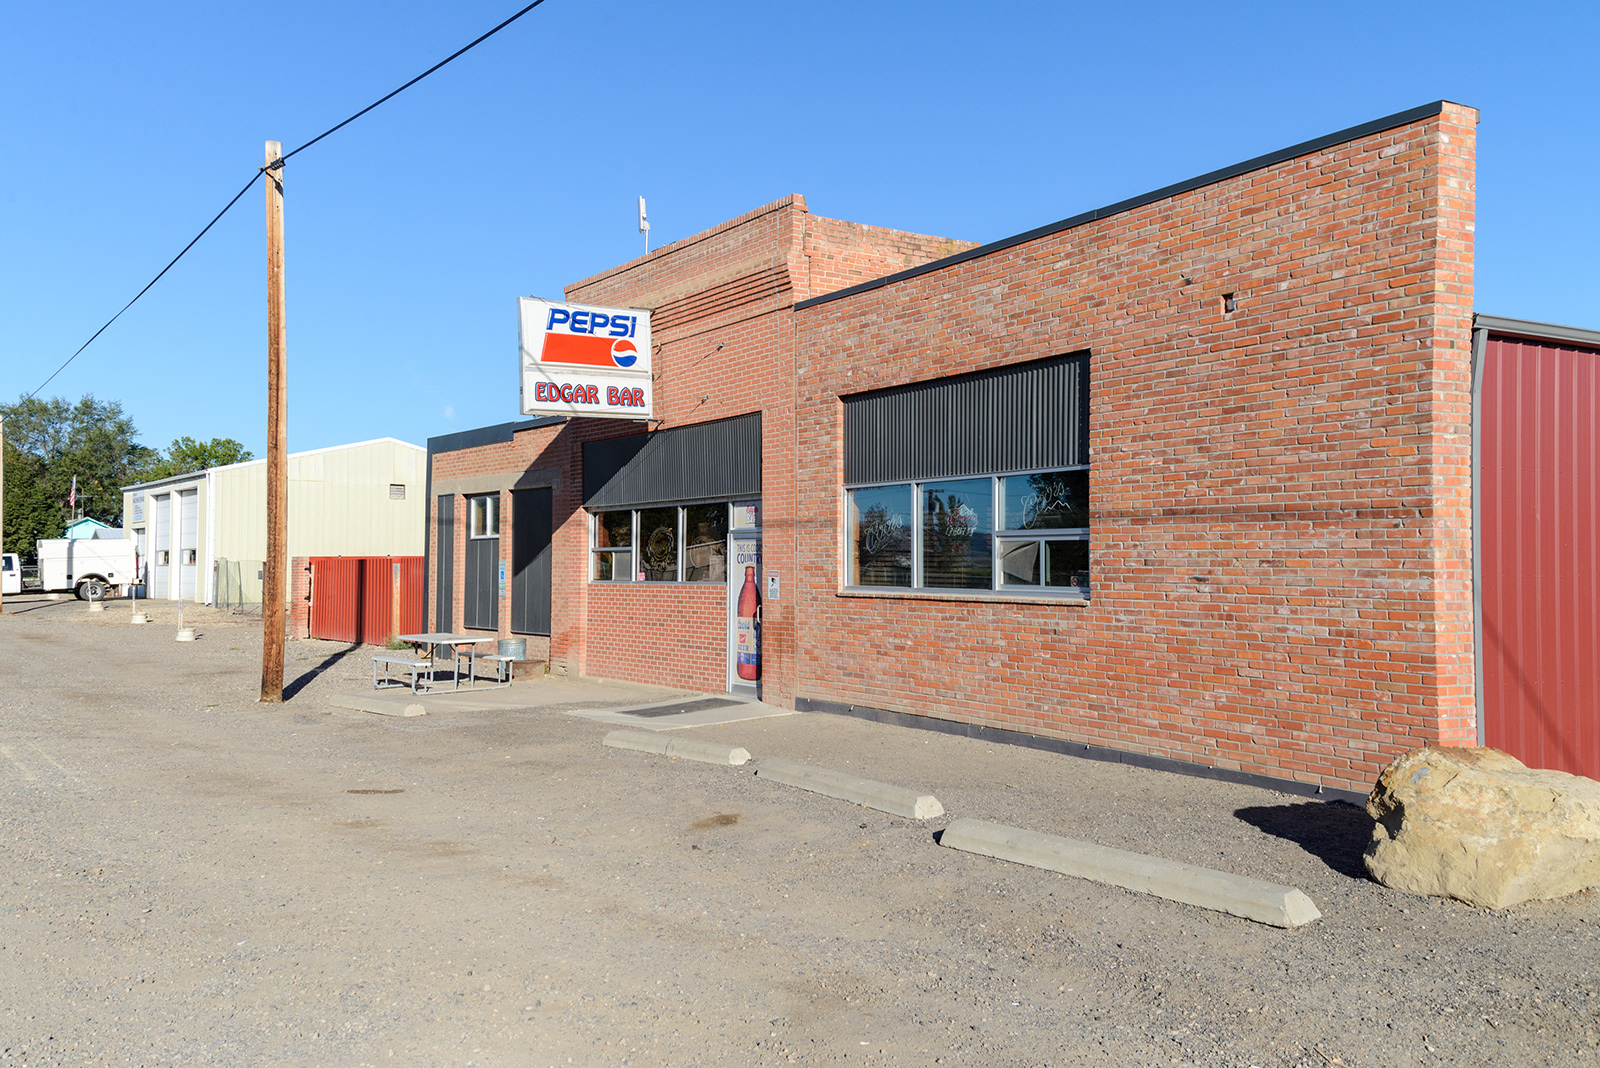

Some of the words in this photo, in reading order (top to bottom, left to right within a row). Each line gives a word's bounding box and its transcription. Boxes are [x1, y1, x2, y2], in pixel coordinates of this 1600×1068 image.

[546, 308, 637, 338] PEPSI
[535, 382, 599, 404] EDGAR
[607, 386, 645, 407] BAR
